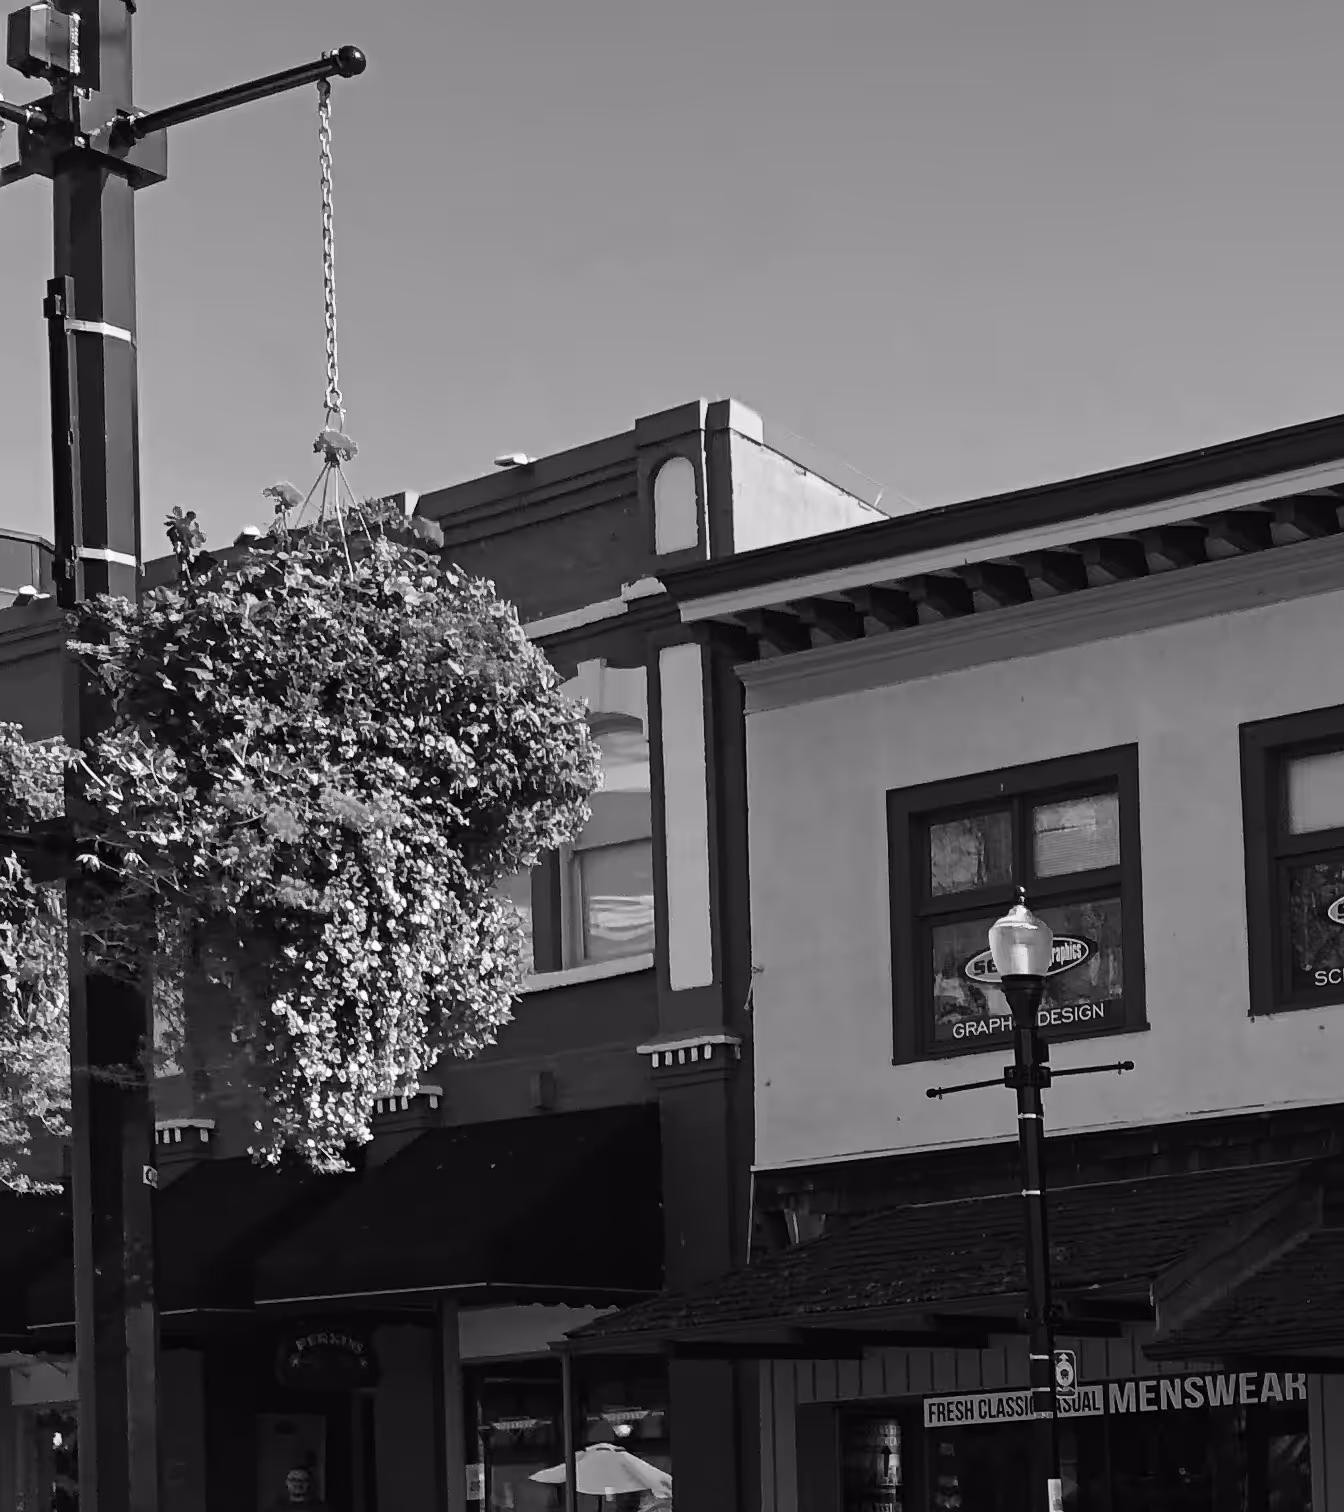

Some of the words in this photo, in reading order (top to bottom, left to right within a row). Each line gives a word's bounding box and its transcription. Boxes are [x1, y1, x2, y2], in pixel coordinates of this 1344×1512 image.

[1049, 942, 1082, 966] raphics
[952, 1016, 1013, 1039] GRAPH
[1038, 1003, 1105, 1026] DESIGN
[928, 1399, 974, 1424] FRESH
[1057, 1391, 1101, 1414] ASUAL
[1109, 1371, 1308, 1415] MENSWEAR
